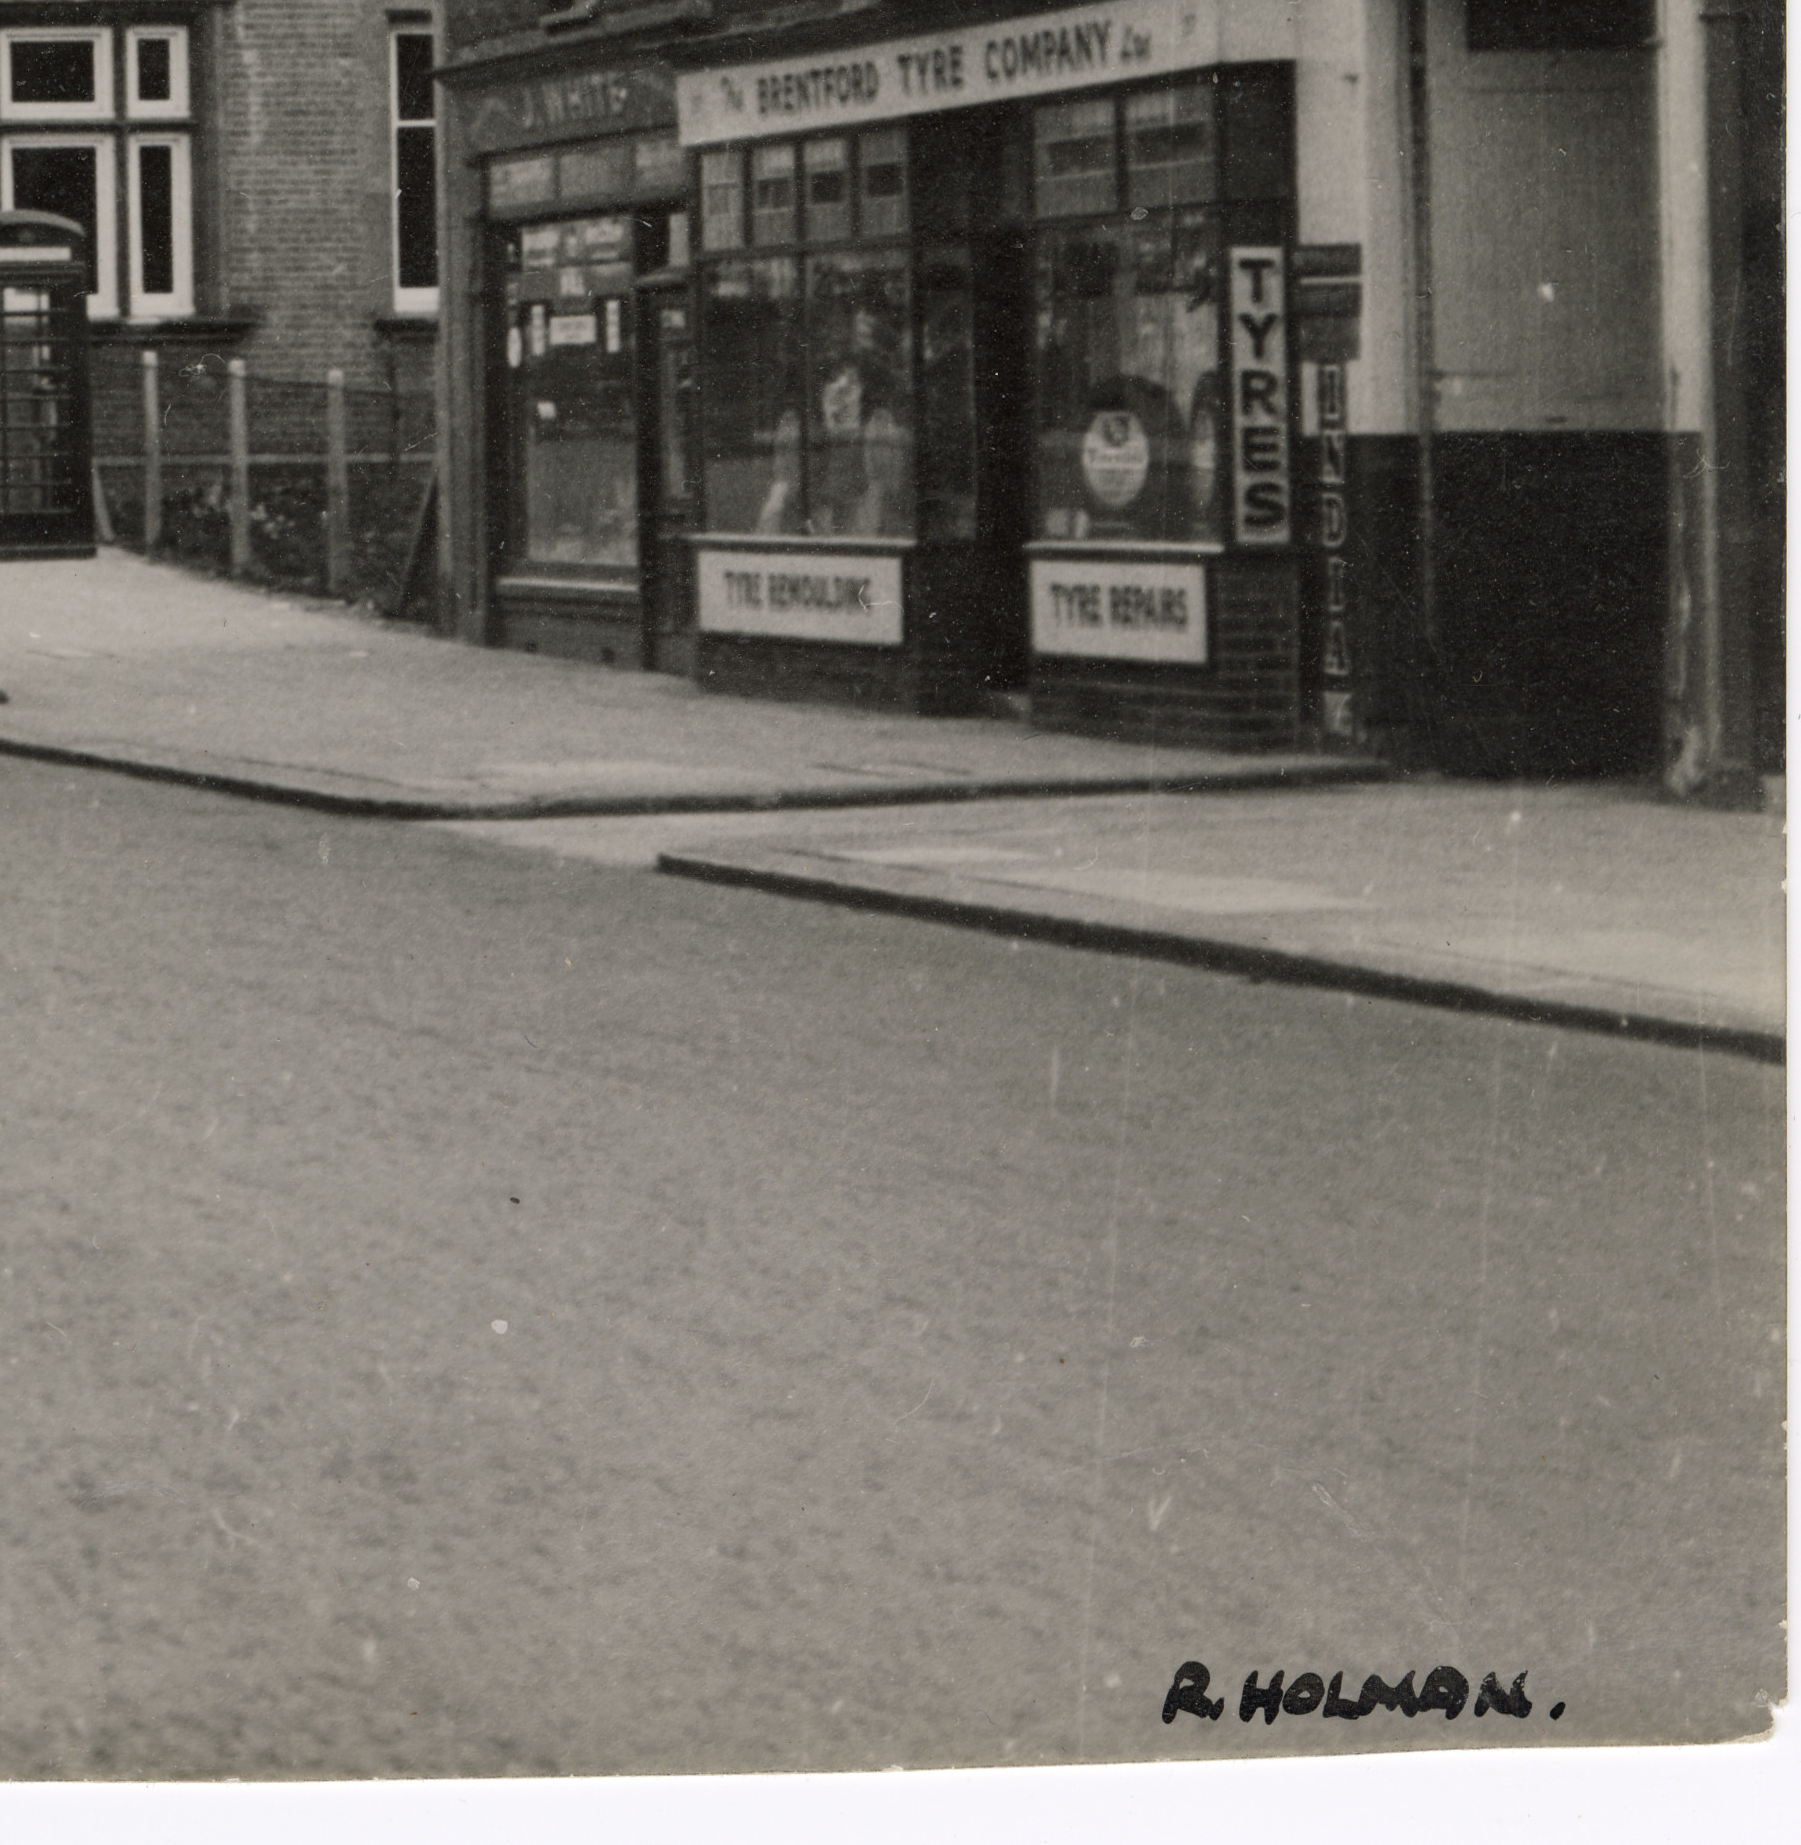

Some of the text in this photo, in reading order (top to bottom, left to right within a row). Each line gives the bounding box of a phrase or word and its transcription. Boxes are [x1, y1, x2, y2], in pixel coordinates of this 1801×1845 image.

[757, 60, 881, 118] BRENTFORD
[897, 44, 963, 97] TYRE
[985, 18, 1113, 84] COMPANY
[1239, 257, 1286, 527] TYRES
[1051, 583, 1188, 636] TYRE REPAIRS
